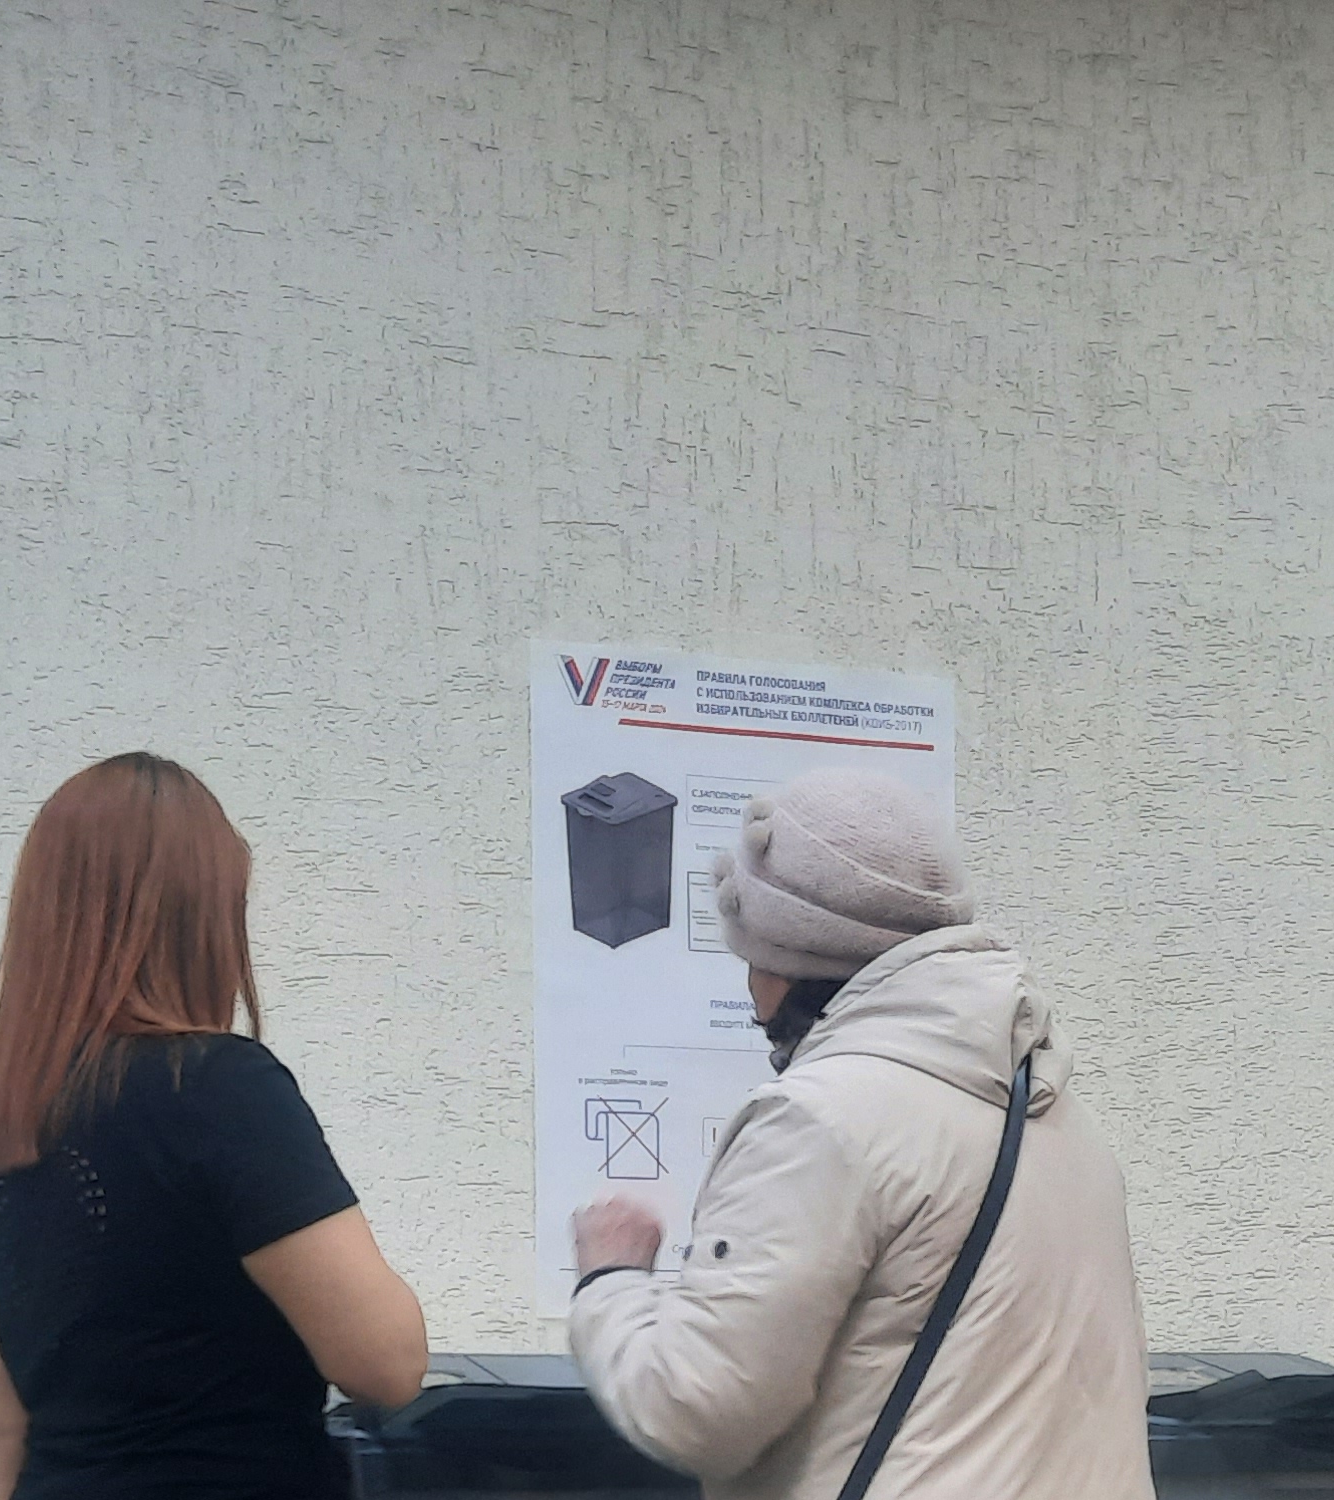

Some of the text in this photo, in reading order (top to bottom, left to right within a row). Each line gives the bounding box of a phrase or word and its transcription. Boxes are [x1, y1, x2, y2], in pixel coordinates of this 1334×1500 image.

[615, 660, 662, 674] ВЫБОРЫ
[609, 673, 676, 689] ПРЕЗИДЕНТА
[696, 670, 826, 692] ПРАВИЛА ГОЛОСОВАНИЯ
[605, 687, 648, 700] РОССИИ
[696, 687, 934, 717] С ИСПОЛЬЗОВАНИЕМ КОМПЛЕКСА ОБРАБОТКИ
[696, 703, 789, 720] ИЗБИРАТЕЛЬНЫХ
[791, 711, 859, 727] БЮЛЛЕТЕНЕЙ
